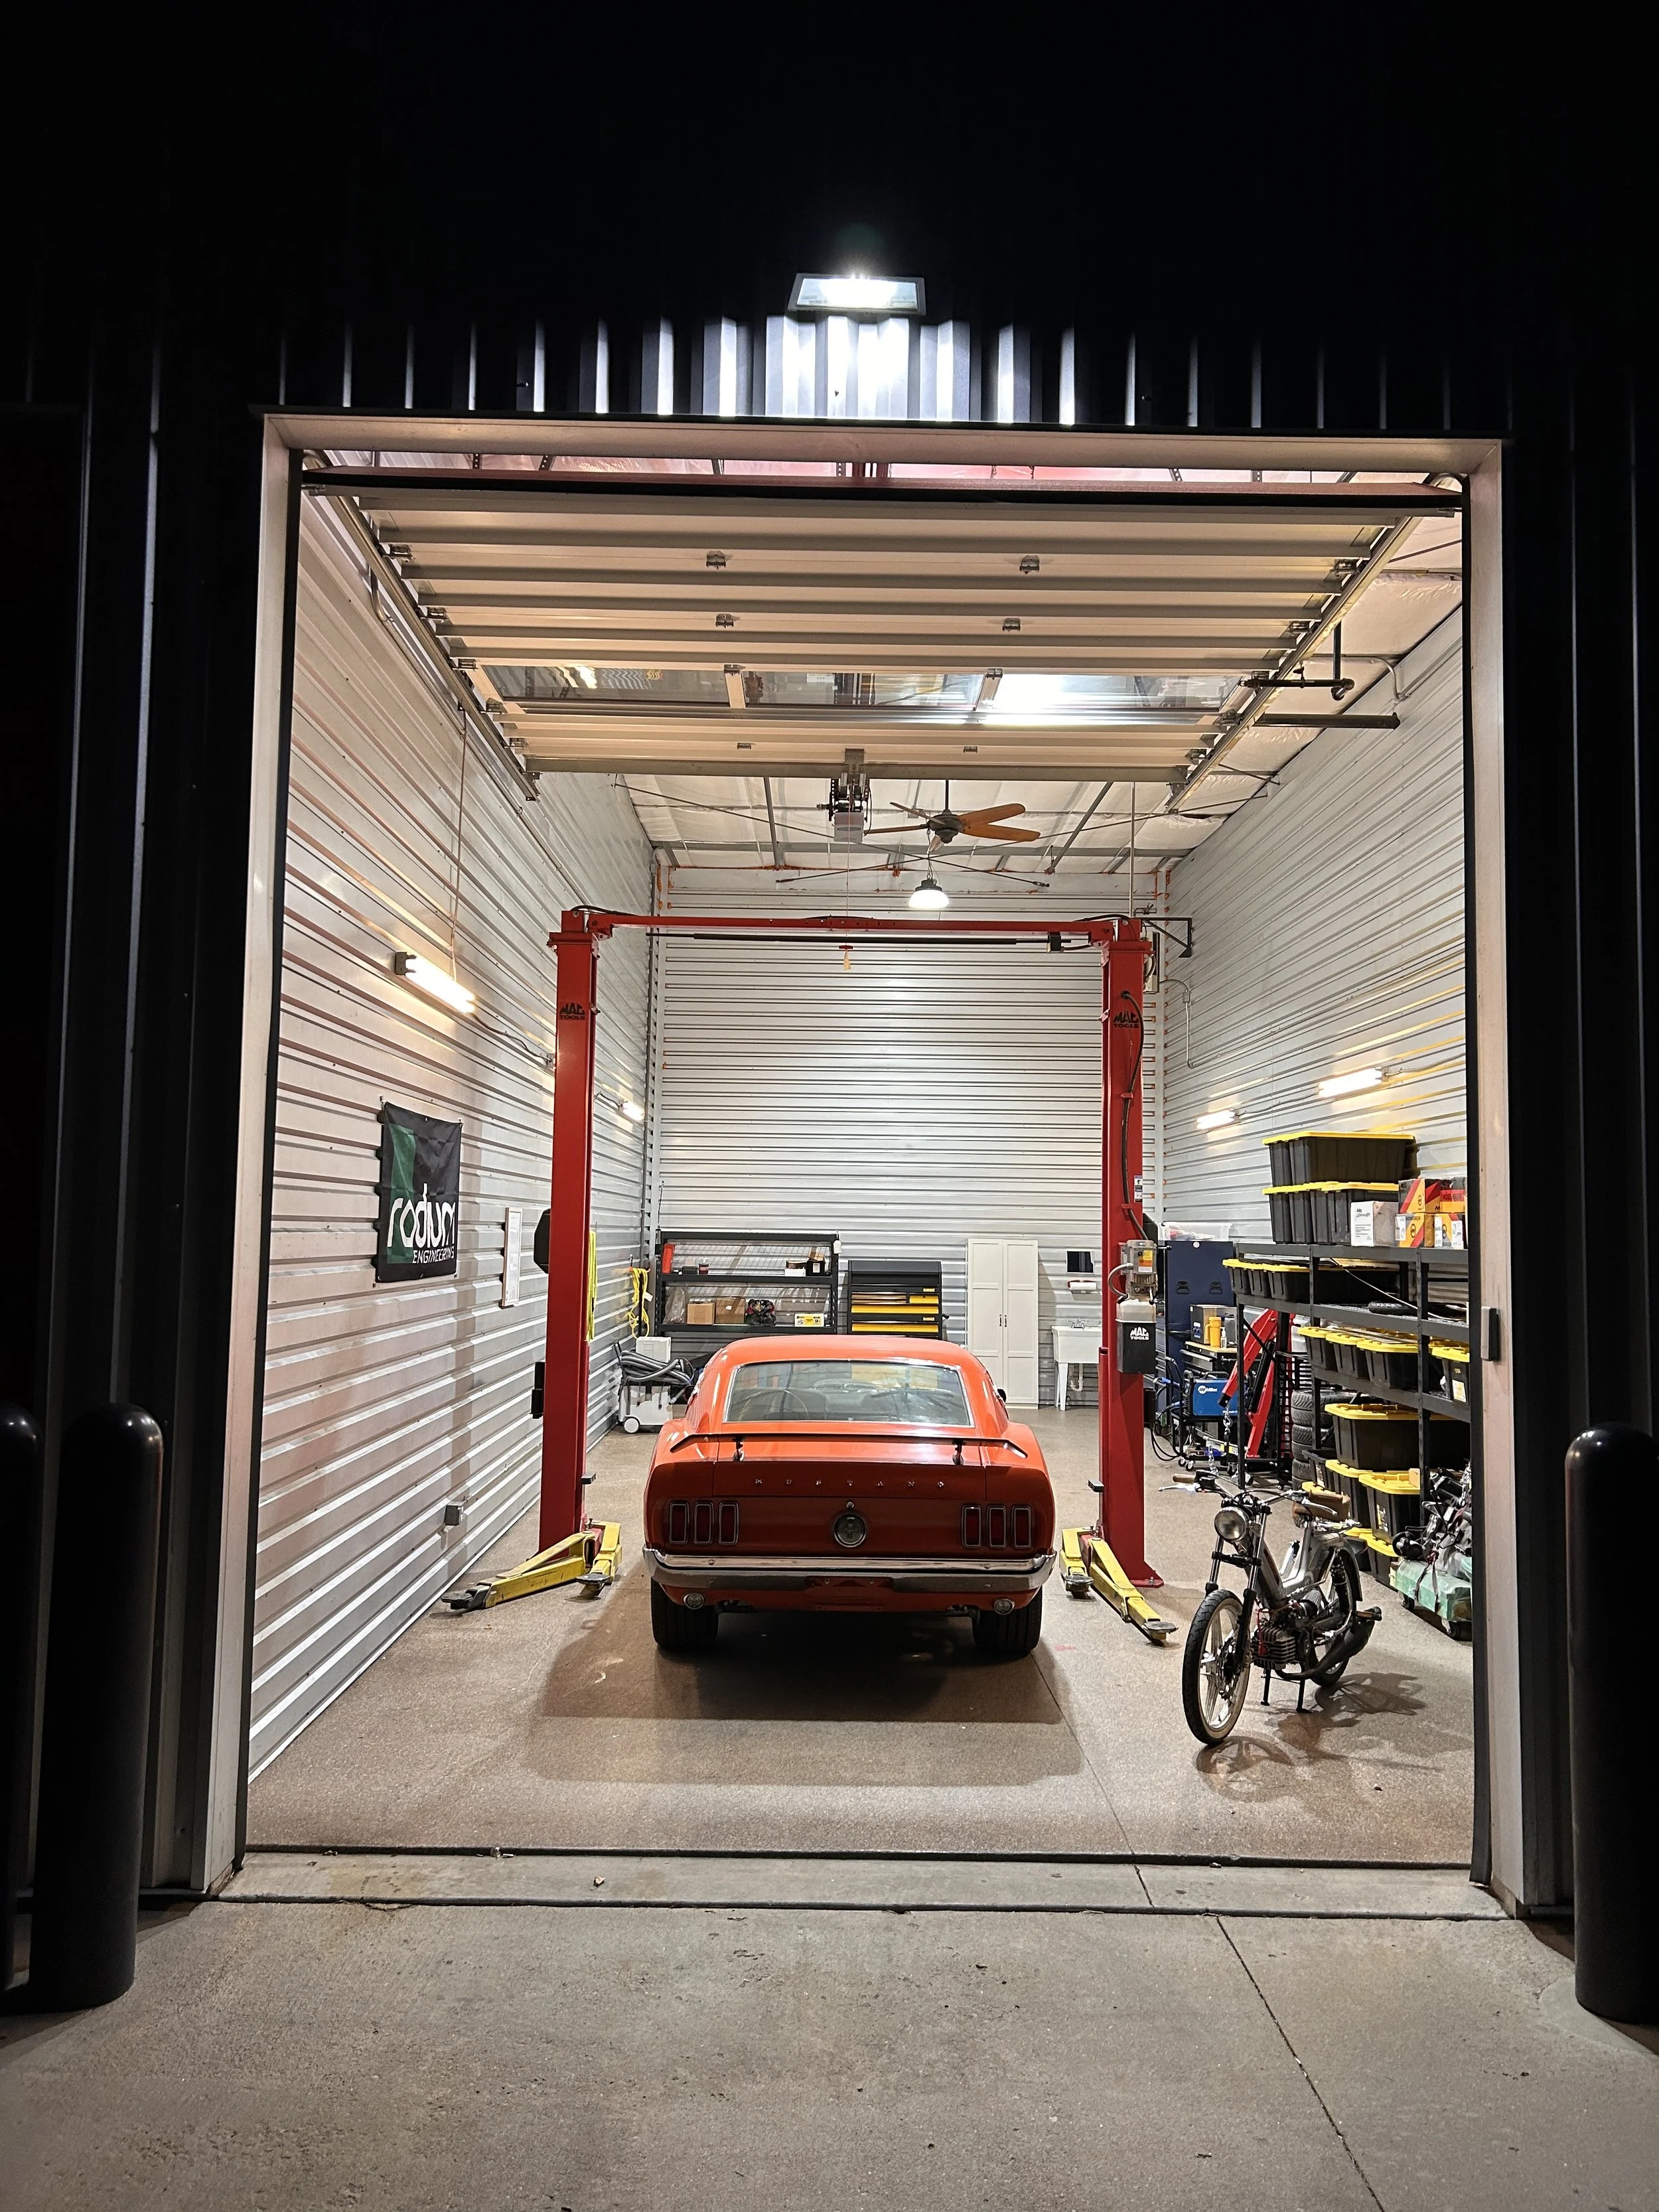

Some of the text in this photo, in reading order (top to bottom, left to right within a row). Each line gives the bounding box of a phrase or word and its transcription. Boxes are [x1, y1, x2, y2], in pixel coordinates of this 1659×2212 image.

[559, 1002, 585, 1014] MAC
[1114, 1011, 1139, 1023] MAC
[412, 1248, 455, 1264] ENGINEERING
[1130, 1327, 1149, 1336] MAC
[755, 1477, 945, 1488] MUSTANG
